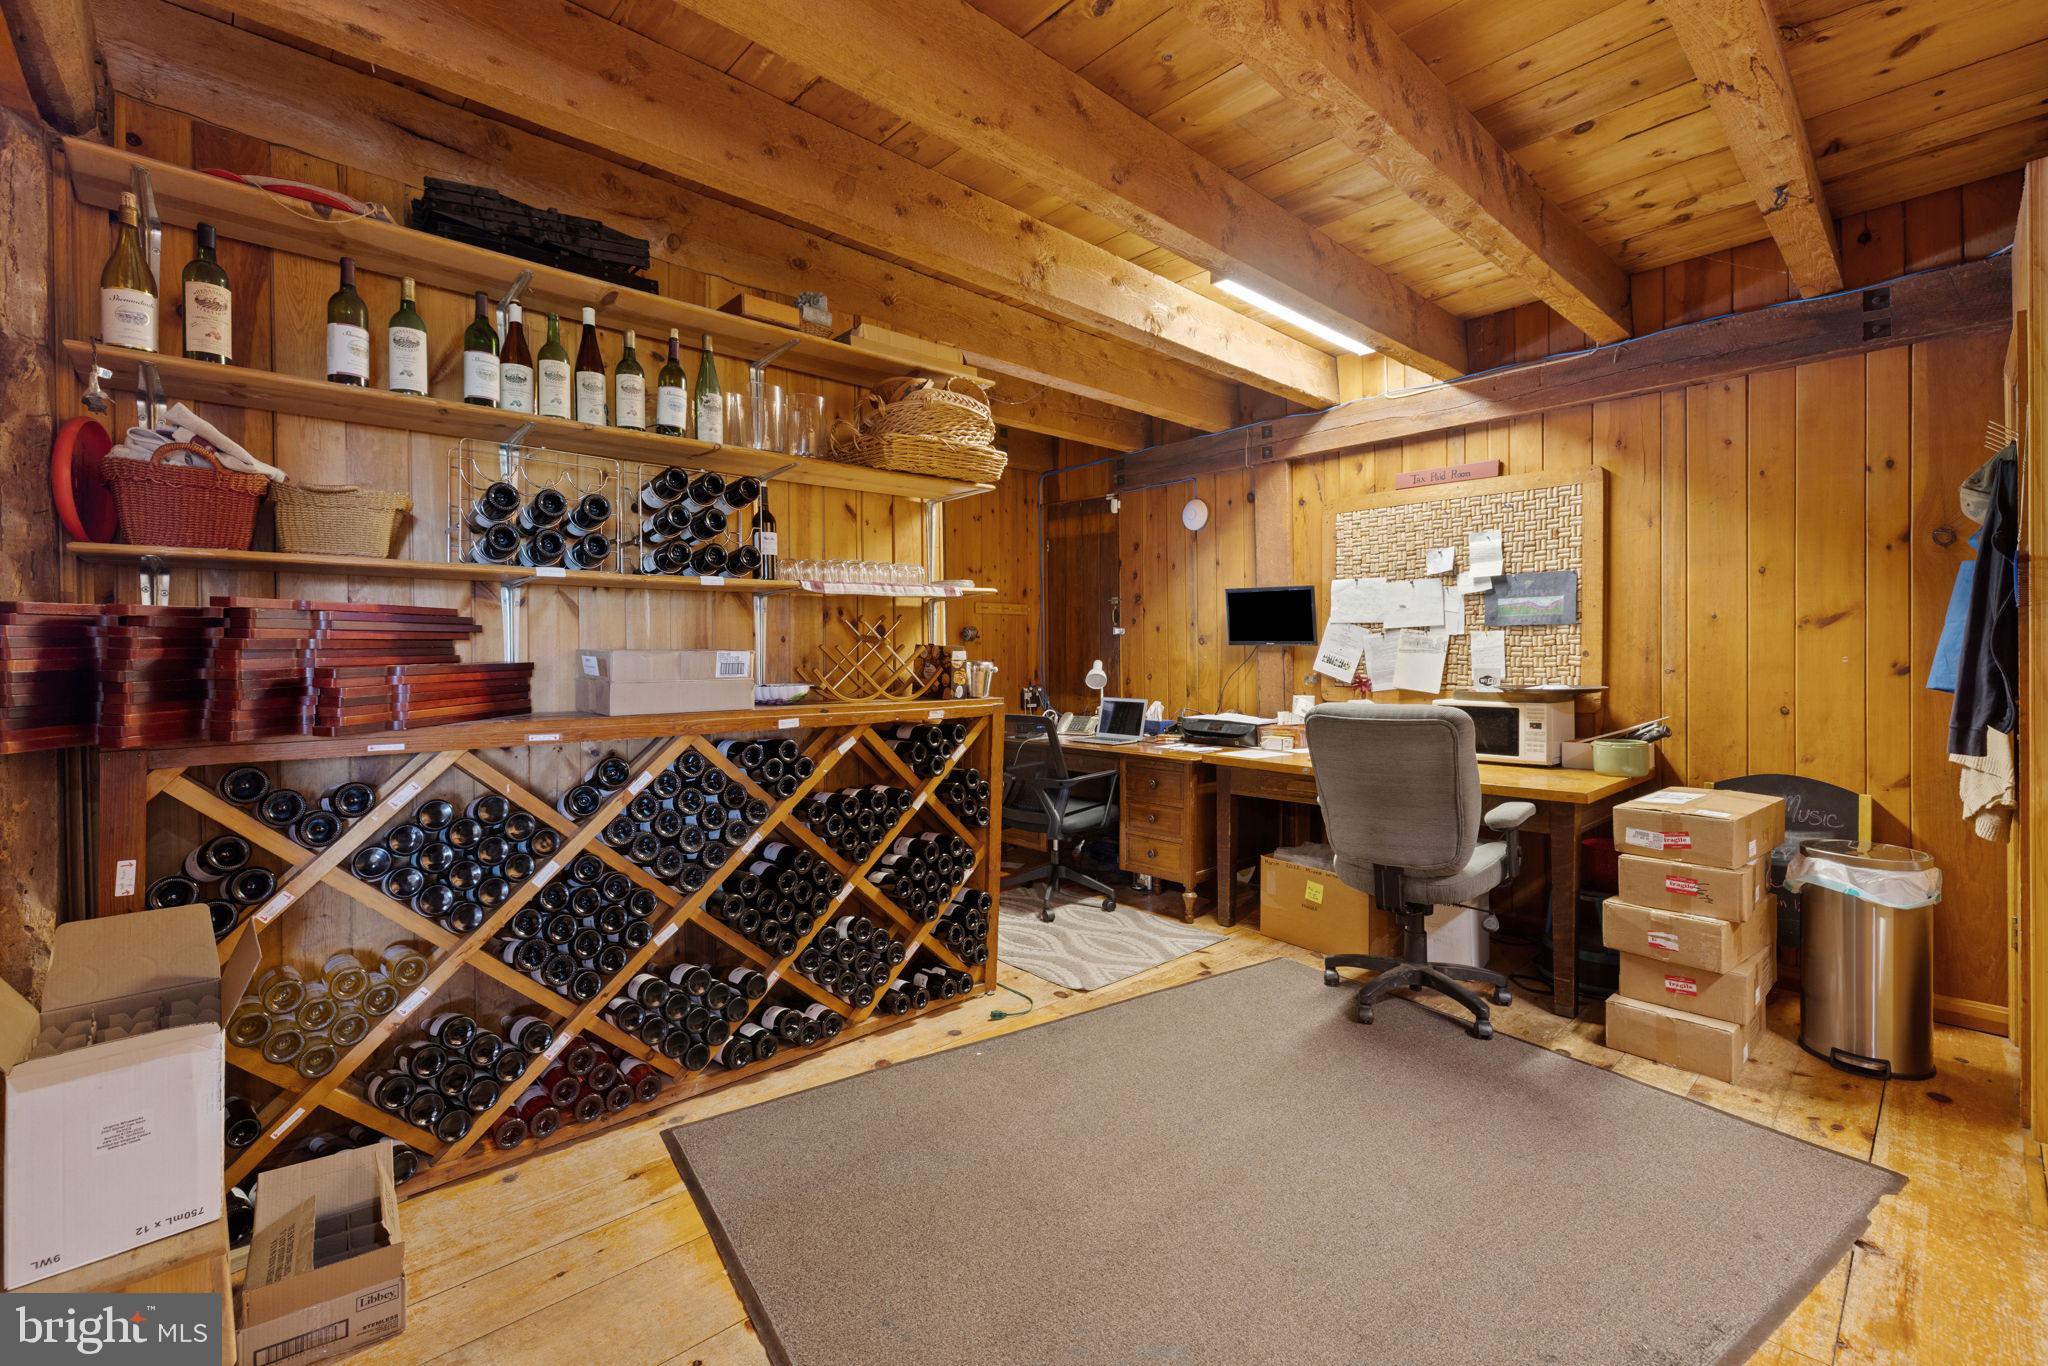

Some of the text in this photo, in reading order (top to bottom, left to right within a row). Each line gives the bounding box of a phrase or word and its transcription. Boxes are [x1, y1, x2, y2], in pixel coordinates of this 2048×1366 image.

[1410, 474, 1425, 485] Tax
[1451, 469, 1471, 479] Room
[135, 1206, 205, 1236] 750mL x 12
[30, 1254, 61, 1270] 9WL
[362, 1313, 399, 1330] STEMLESS
